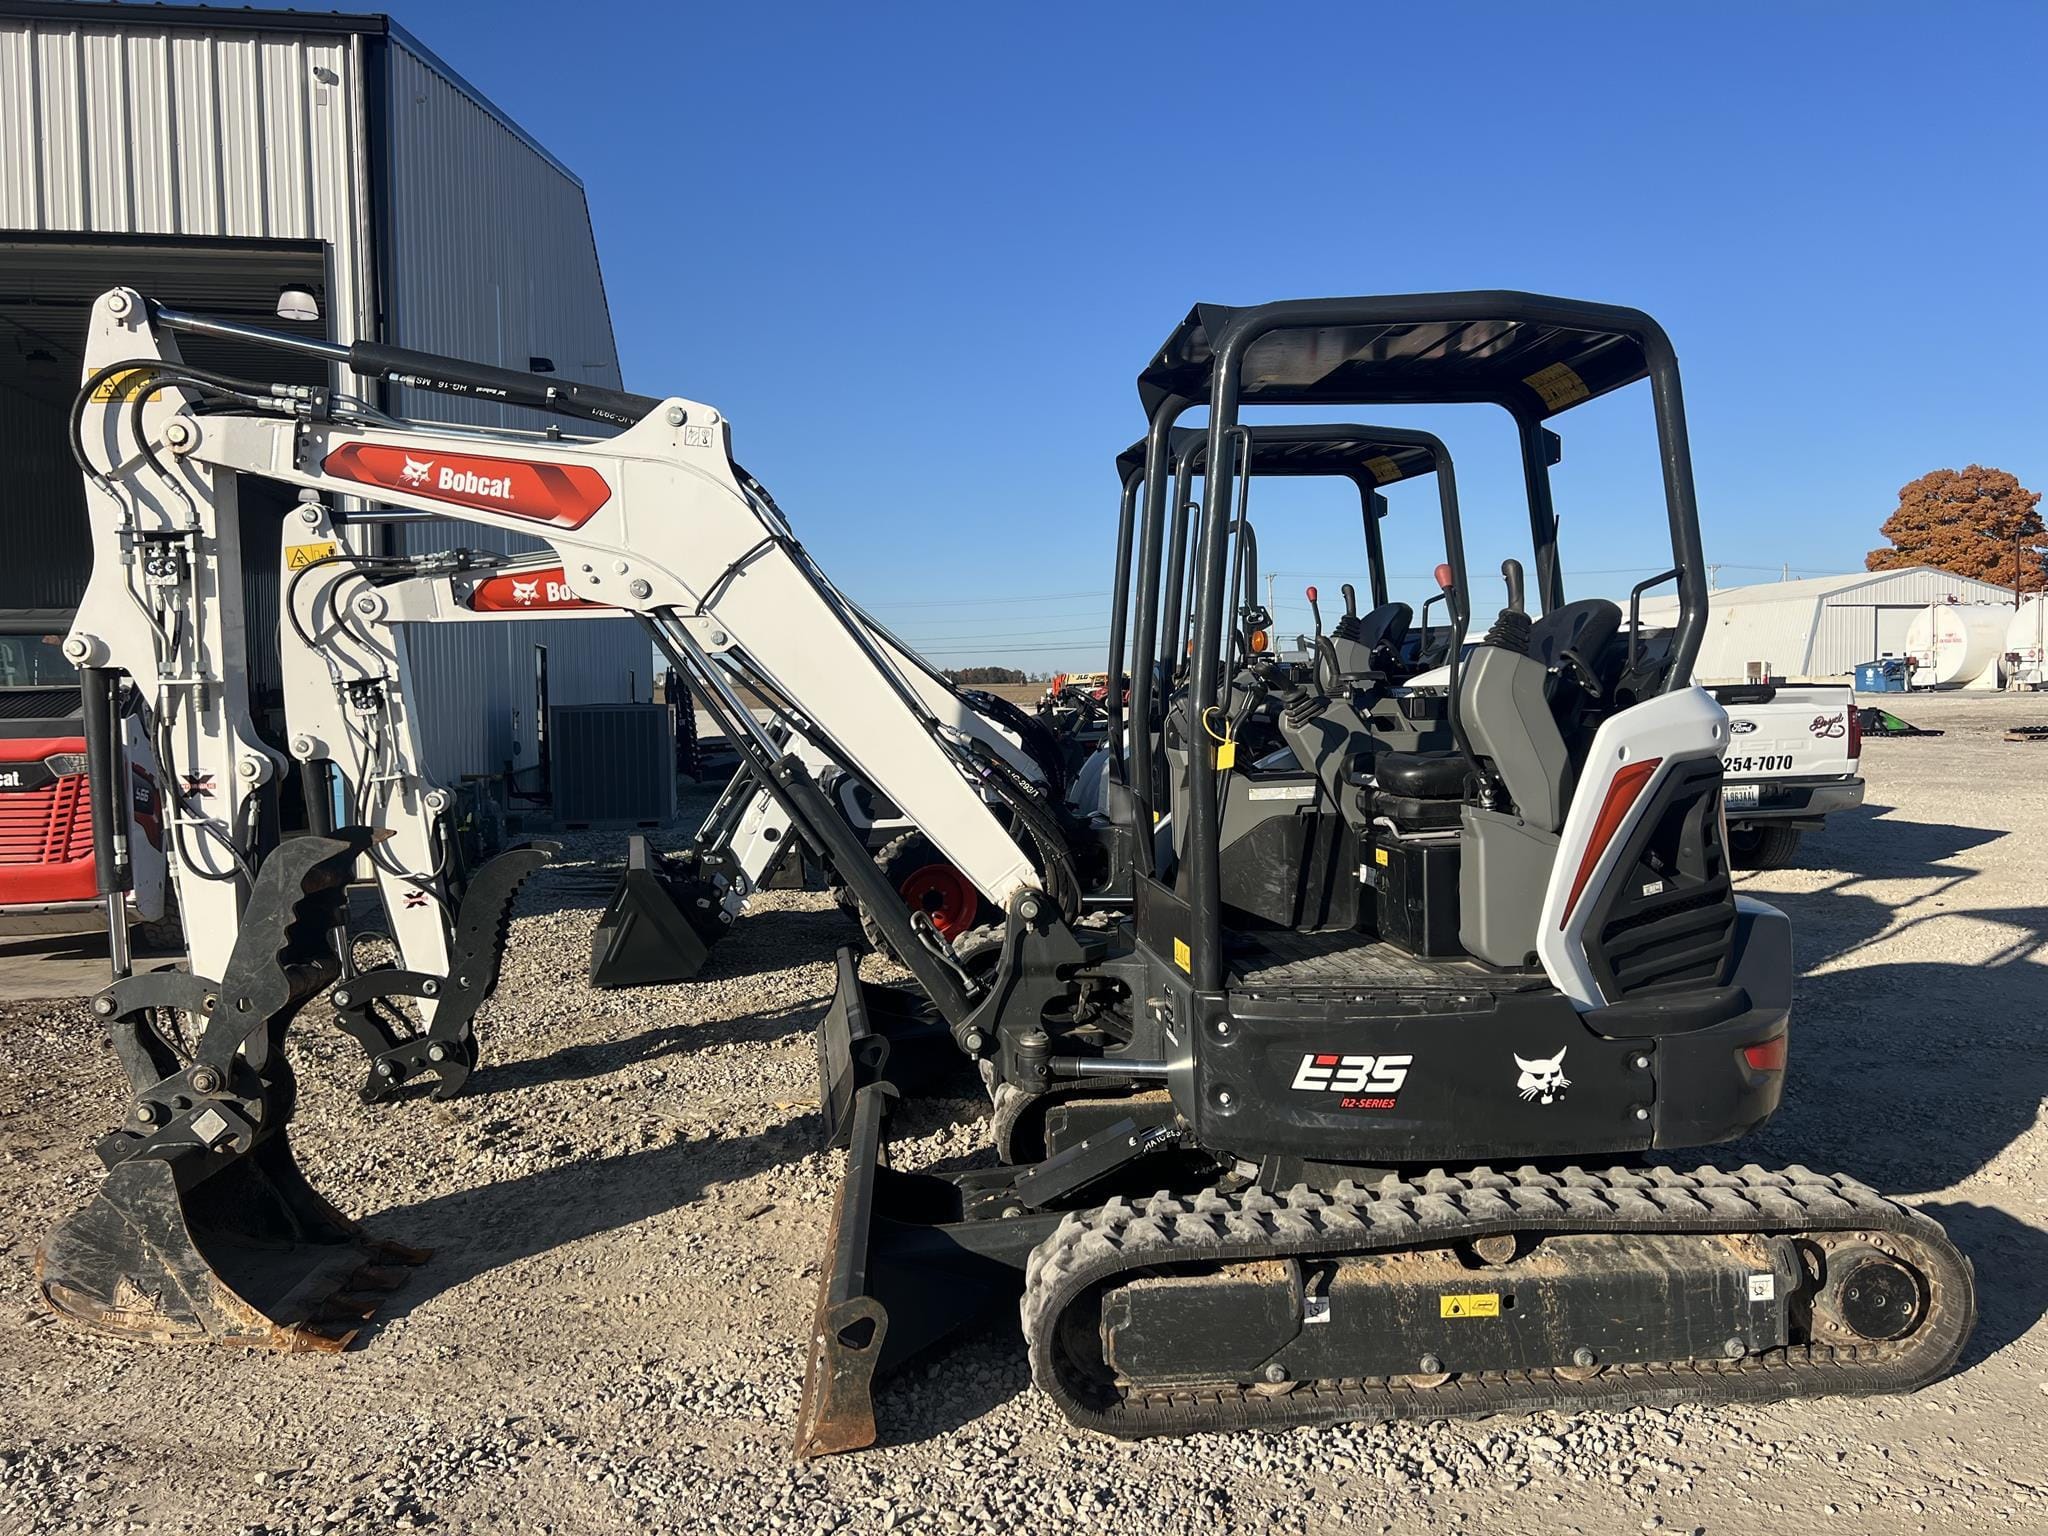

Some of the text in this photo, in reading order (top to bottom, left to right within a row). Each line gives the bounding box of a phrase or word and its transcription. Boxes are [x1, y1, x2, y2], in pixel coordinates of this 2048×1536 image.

[438, 381, 468, 391] HG-16
[438, 466, 511, 499] Bobcat
[1731, 721, 1753, 733] Ford
[1724, 755, 1793, 772] 254-7070
[1291, 1054, 1414, 1093] E35
[1341, 1098, 1396, 1109] R2-SERIES
